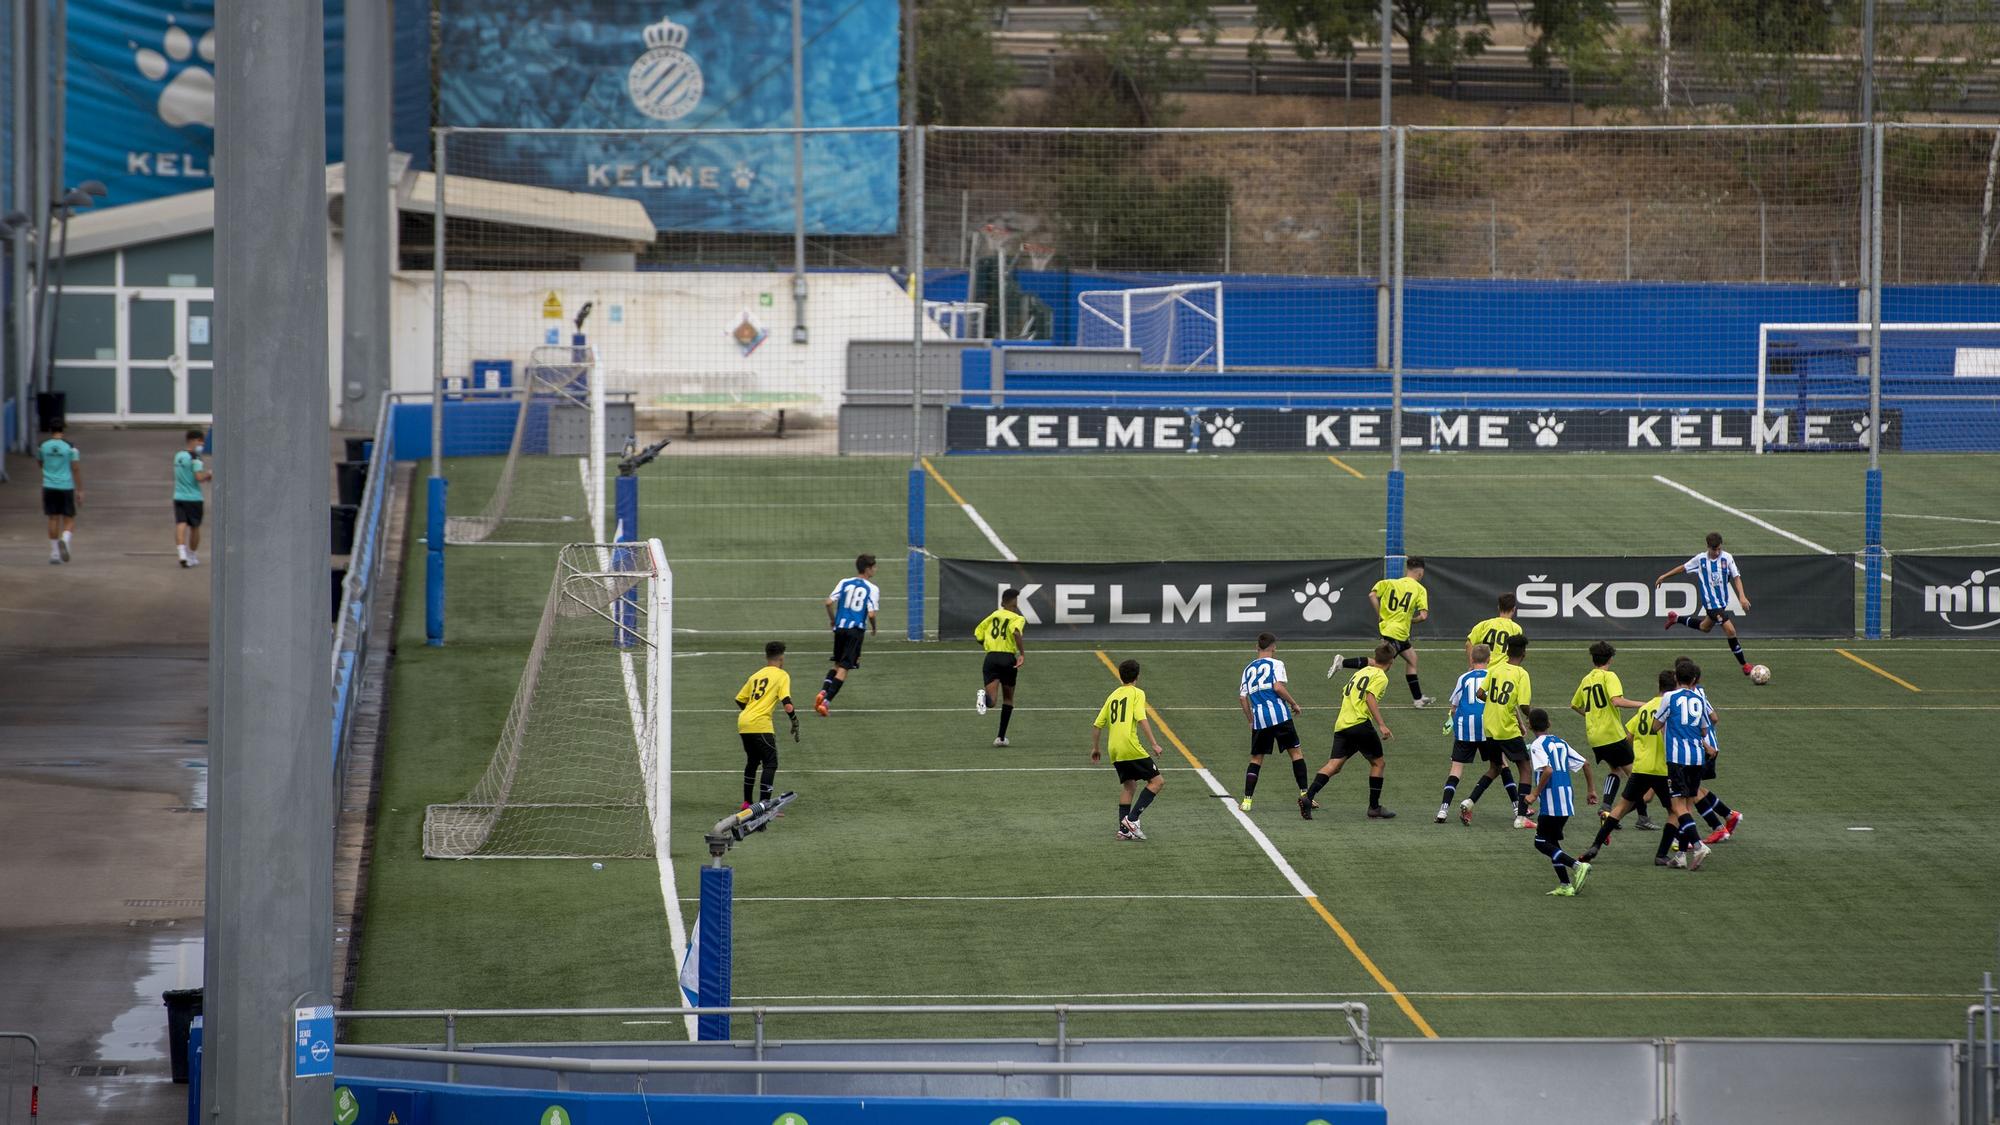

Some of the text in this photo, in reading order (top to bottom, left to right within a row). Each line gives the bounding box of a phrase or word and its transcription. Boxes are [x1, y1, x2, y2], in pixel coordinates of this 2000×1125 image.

[587, 163, 720, 188] KELME
[986, 415, 1185, 448] KELME
[1628, 415, 1831, 448] KELME
[844, 584, 868, 612] 18
[997, 583, 1267, 625] KELME
[1388, 589, 1413, 613] 64
[991, 617, 1010, 640] 84
[1482, 628, 1510, 654] 49
[751, 678, 769, 700] 13
[1247, 663, 1273, 695] 22
[1344, 675, 1370, 701] 69
[1489, 677, 1514, 705] 68
[1110, 697, 1128, 724] 81
[1583, 683, 1608, 713] 70
[1676, 696, 1703, 726] 19
[1547, 741, 1568, 772] 17
